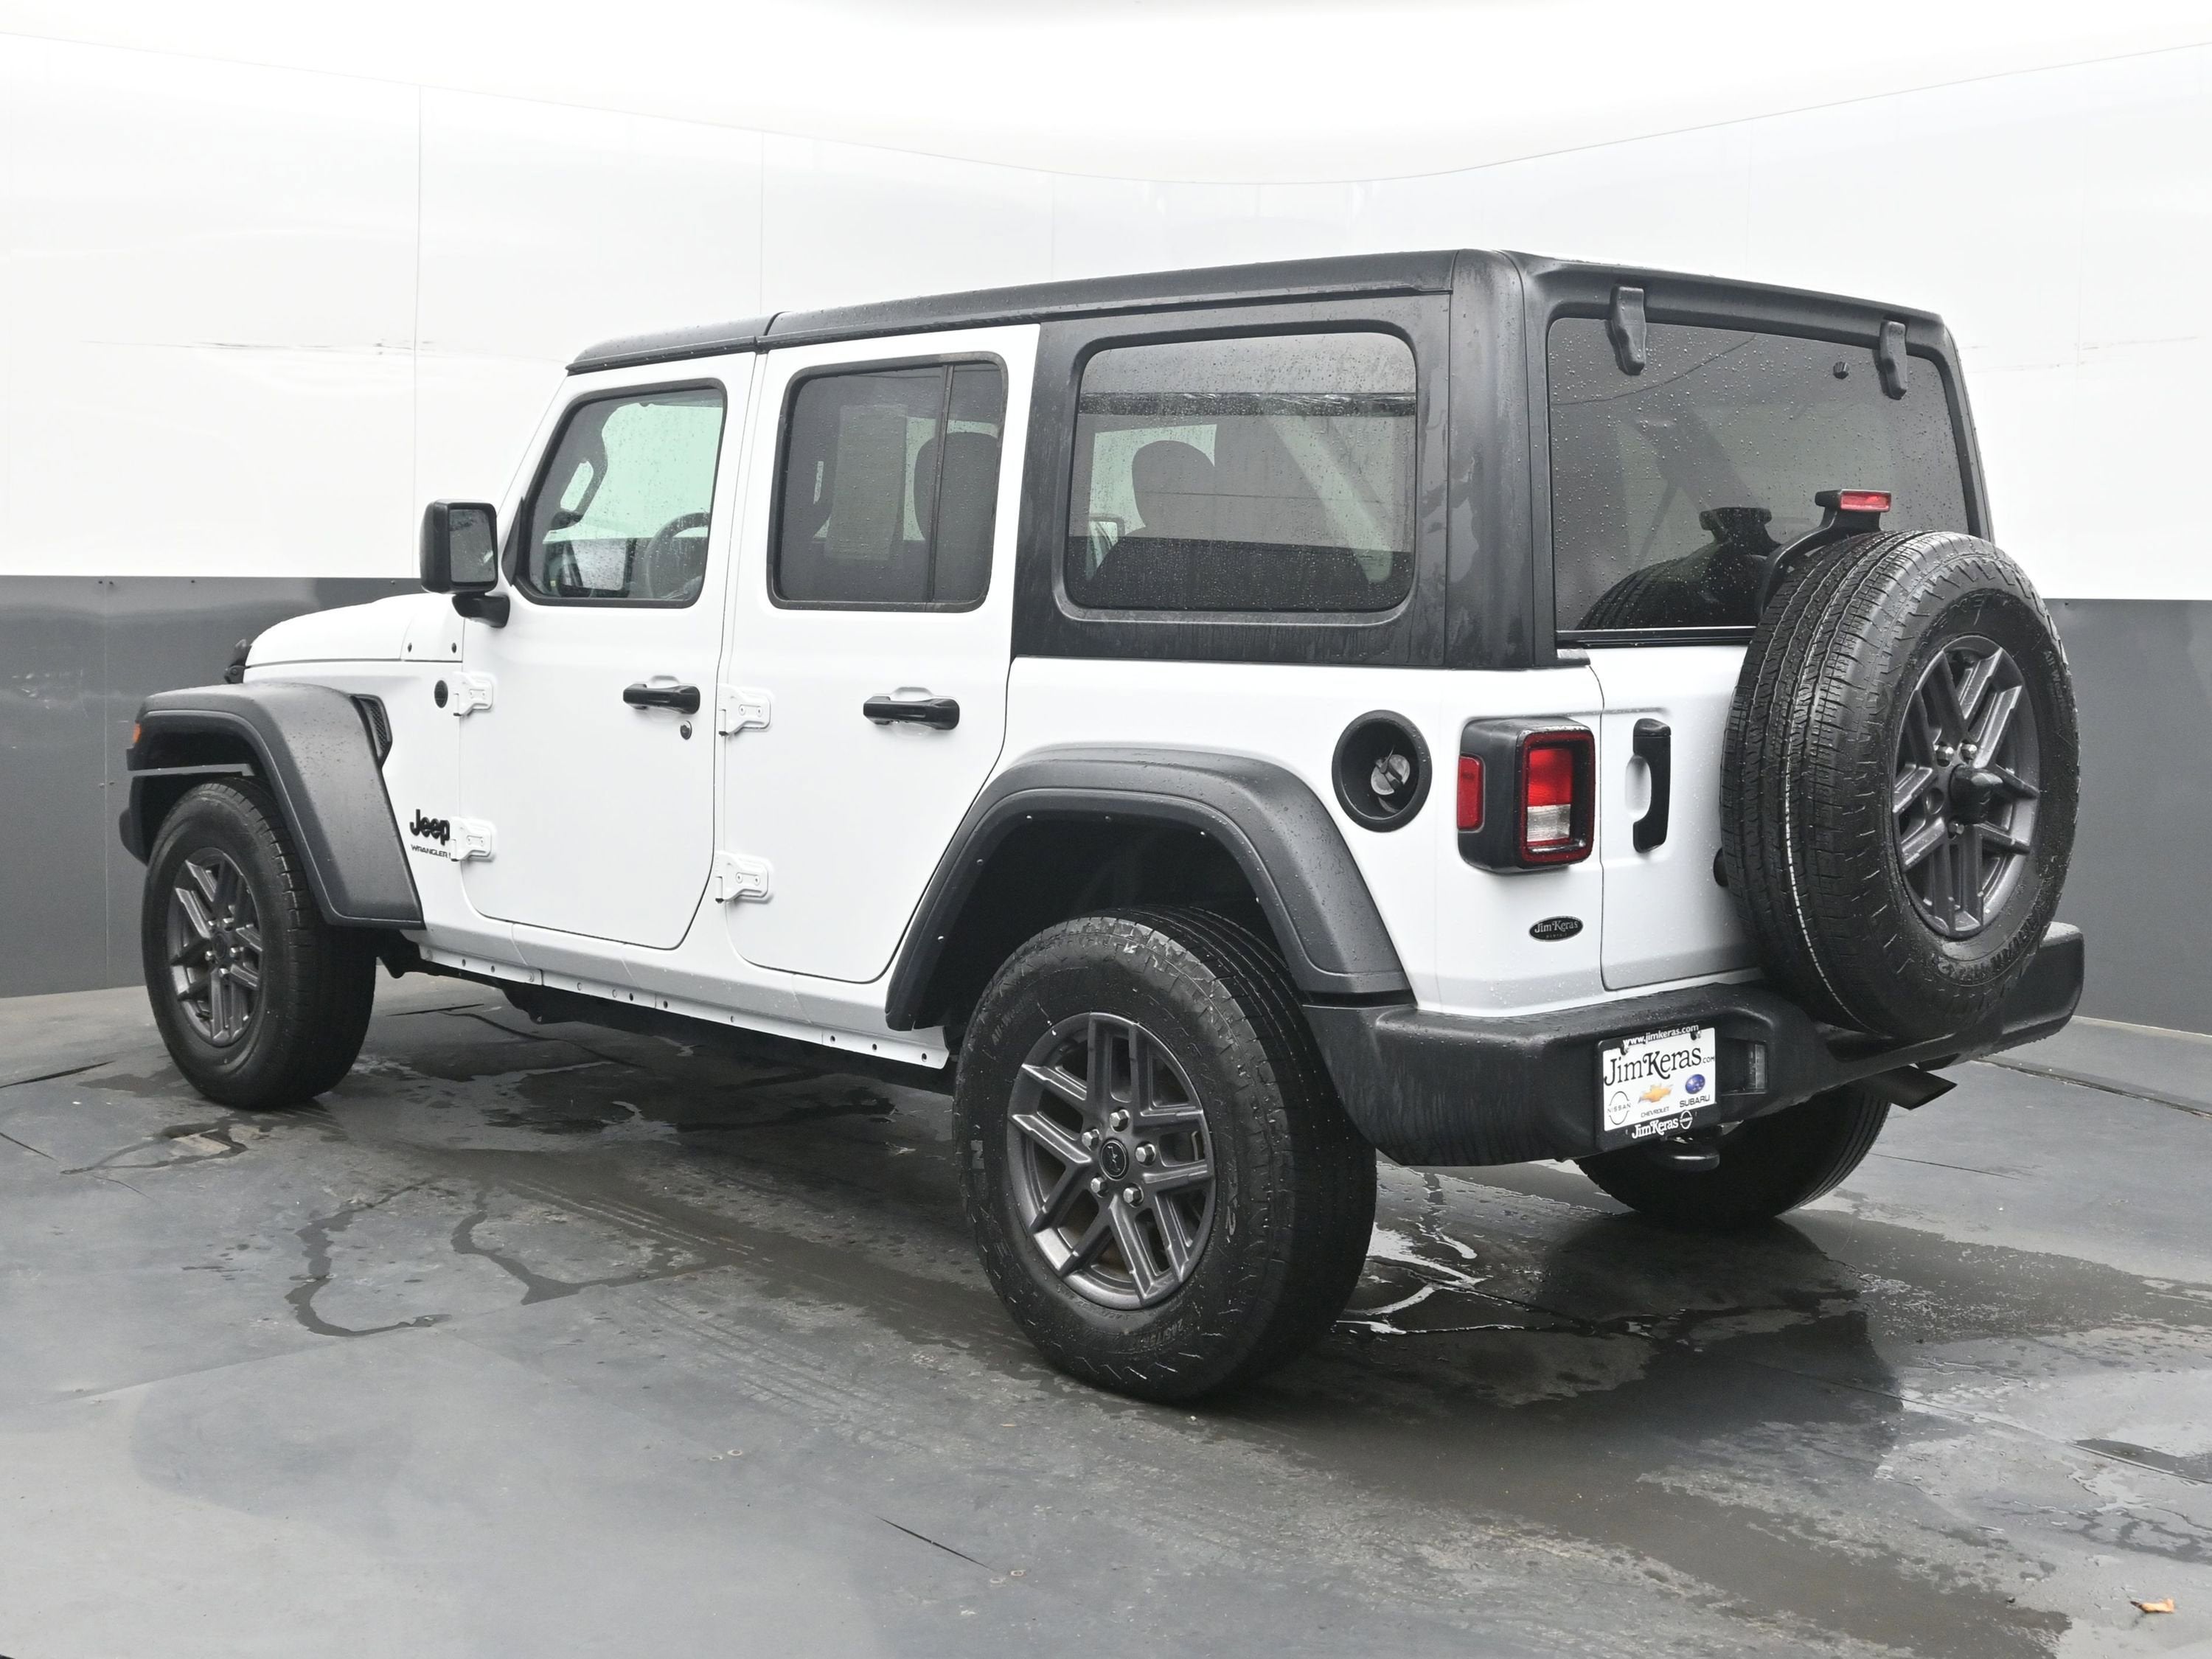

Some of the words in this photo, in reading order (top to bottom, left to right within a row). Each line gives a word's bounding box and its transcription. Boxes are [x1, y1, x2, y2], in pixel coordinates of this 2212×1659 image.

[409, 809, 450, 846] Jeep
[411, 844, 448, 858] WRANGLER
[1623, 1024, 1699, 1045] www.jimkeras.com
[1680, 1094, 1710, 1107] SUBARU
[1607, 1102, 1632, 1113] NISSAN
[1641, 1106, 1670, 1118] CHEVROLET
